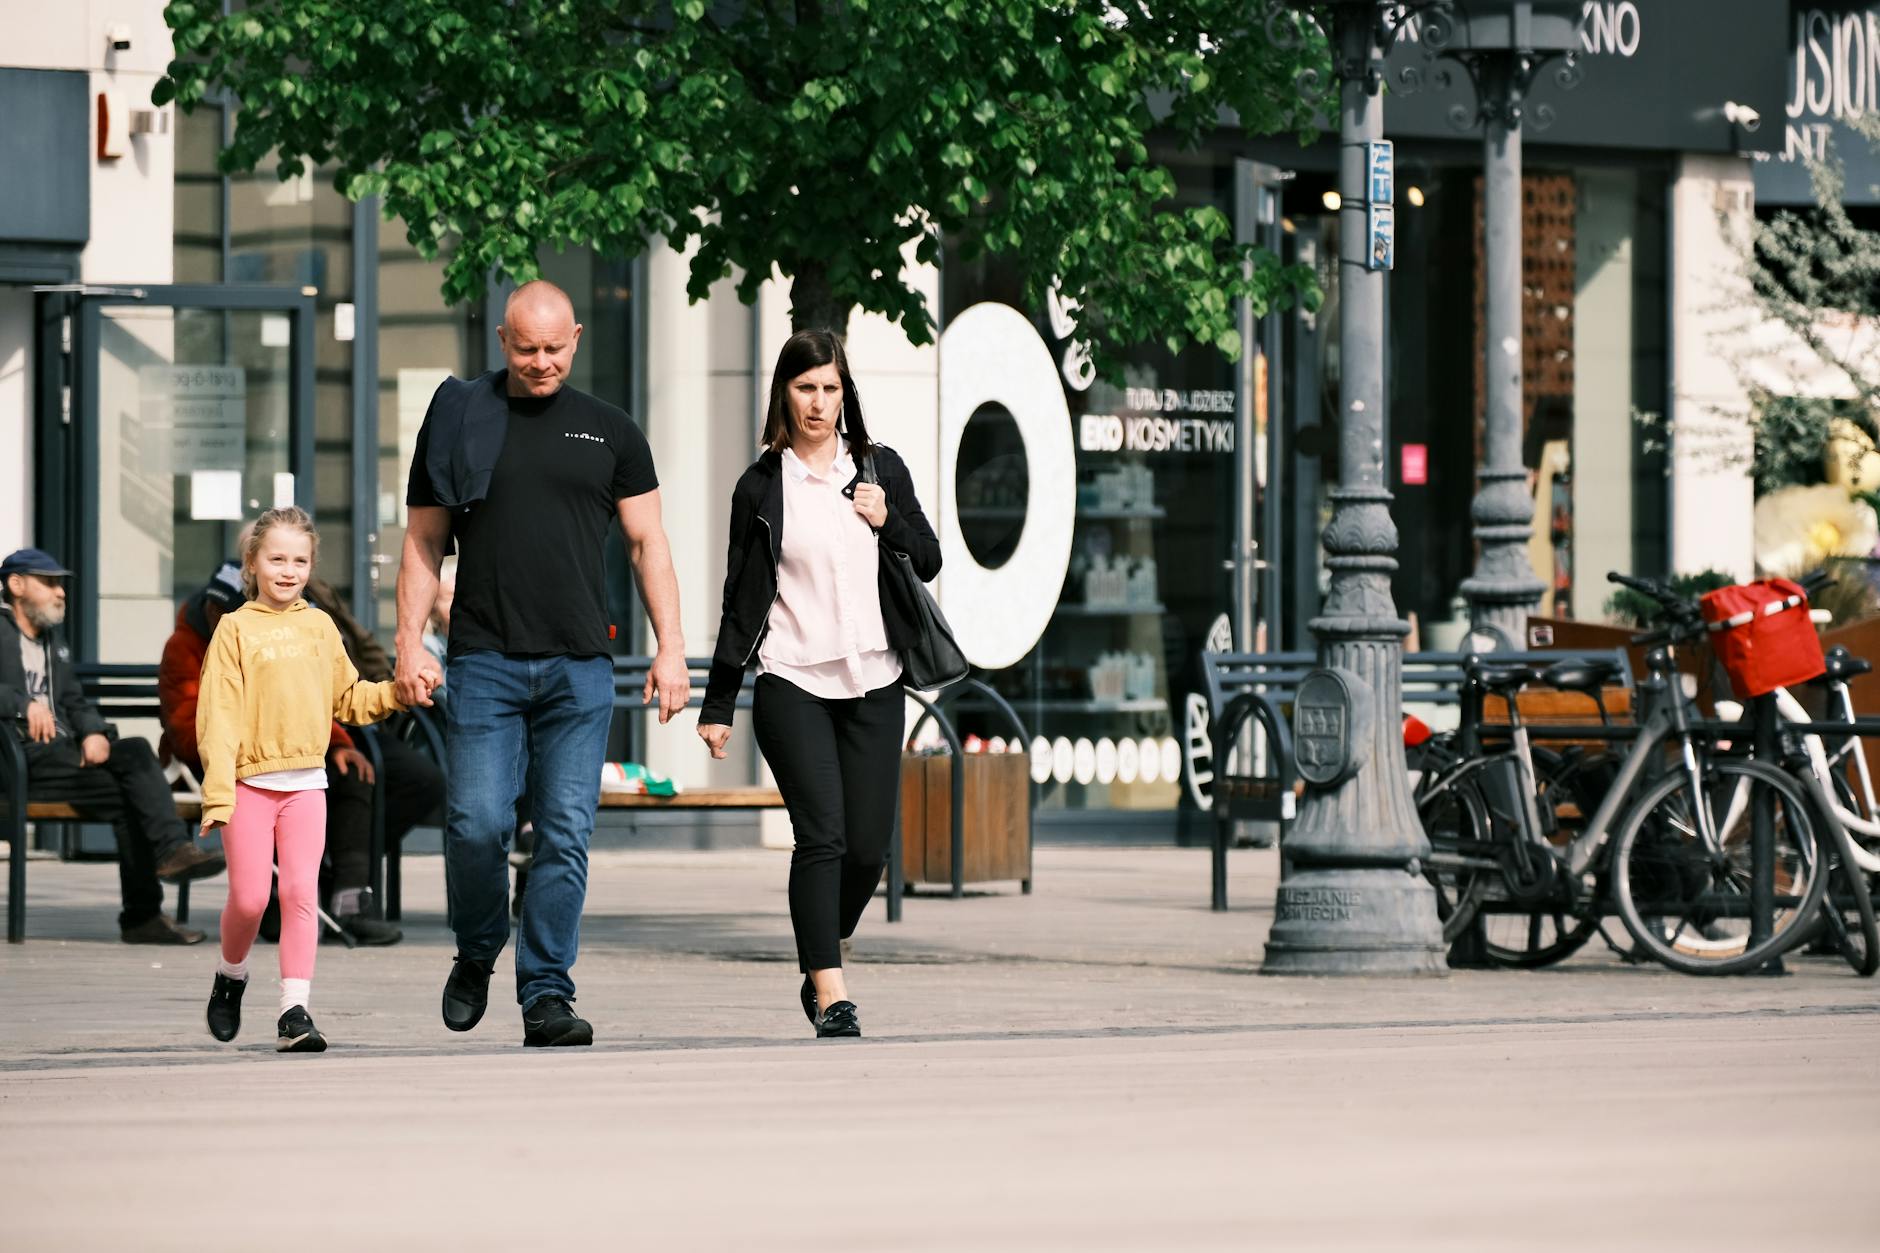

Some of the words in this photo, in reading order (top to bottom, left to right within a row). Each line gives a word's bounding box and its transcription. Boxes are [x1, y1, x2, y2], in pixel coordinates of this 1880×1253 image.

[1579, 1, 1641, 56] KNO
[1126, 387, 1163, 411] TUTAJ
[1164, 388, 1235, 412] ZNAJDZIESZ
[1080, 414, 1124, 451] EKO
[1126, 416, 1235, 452] KOSMETYKI
